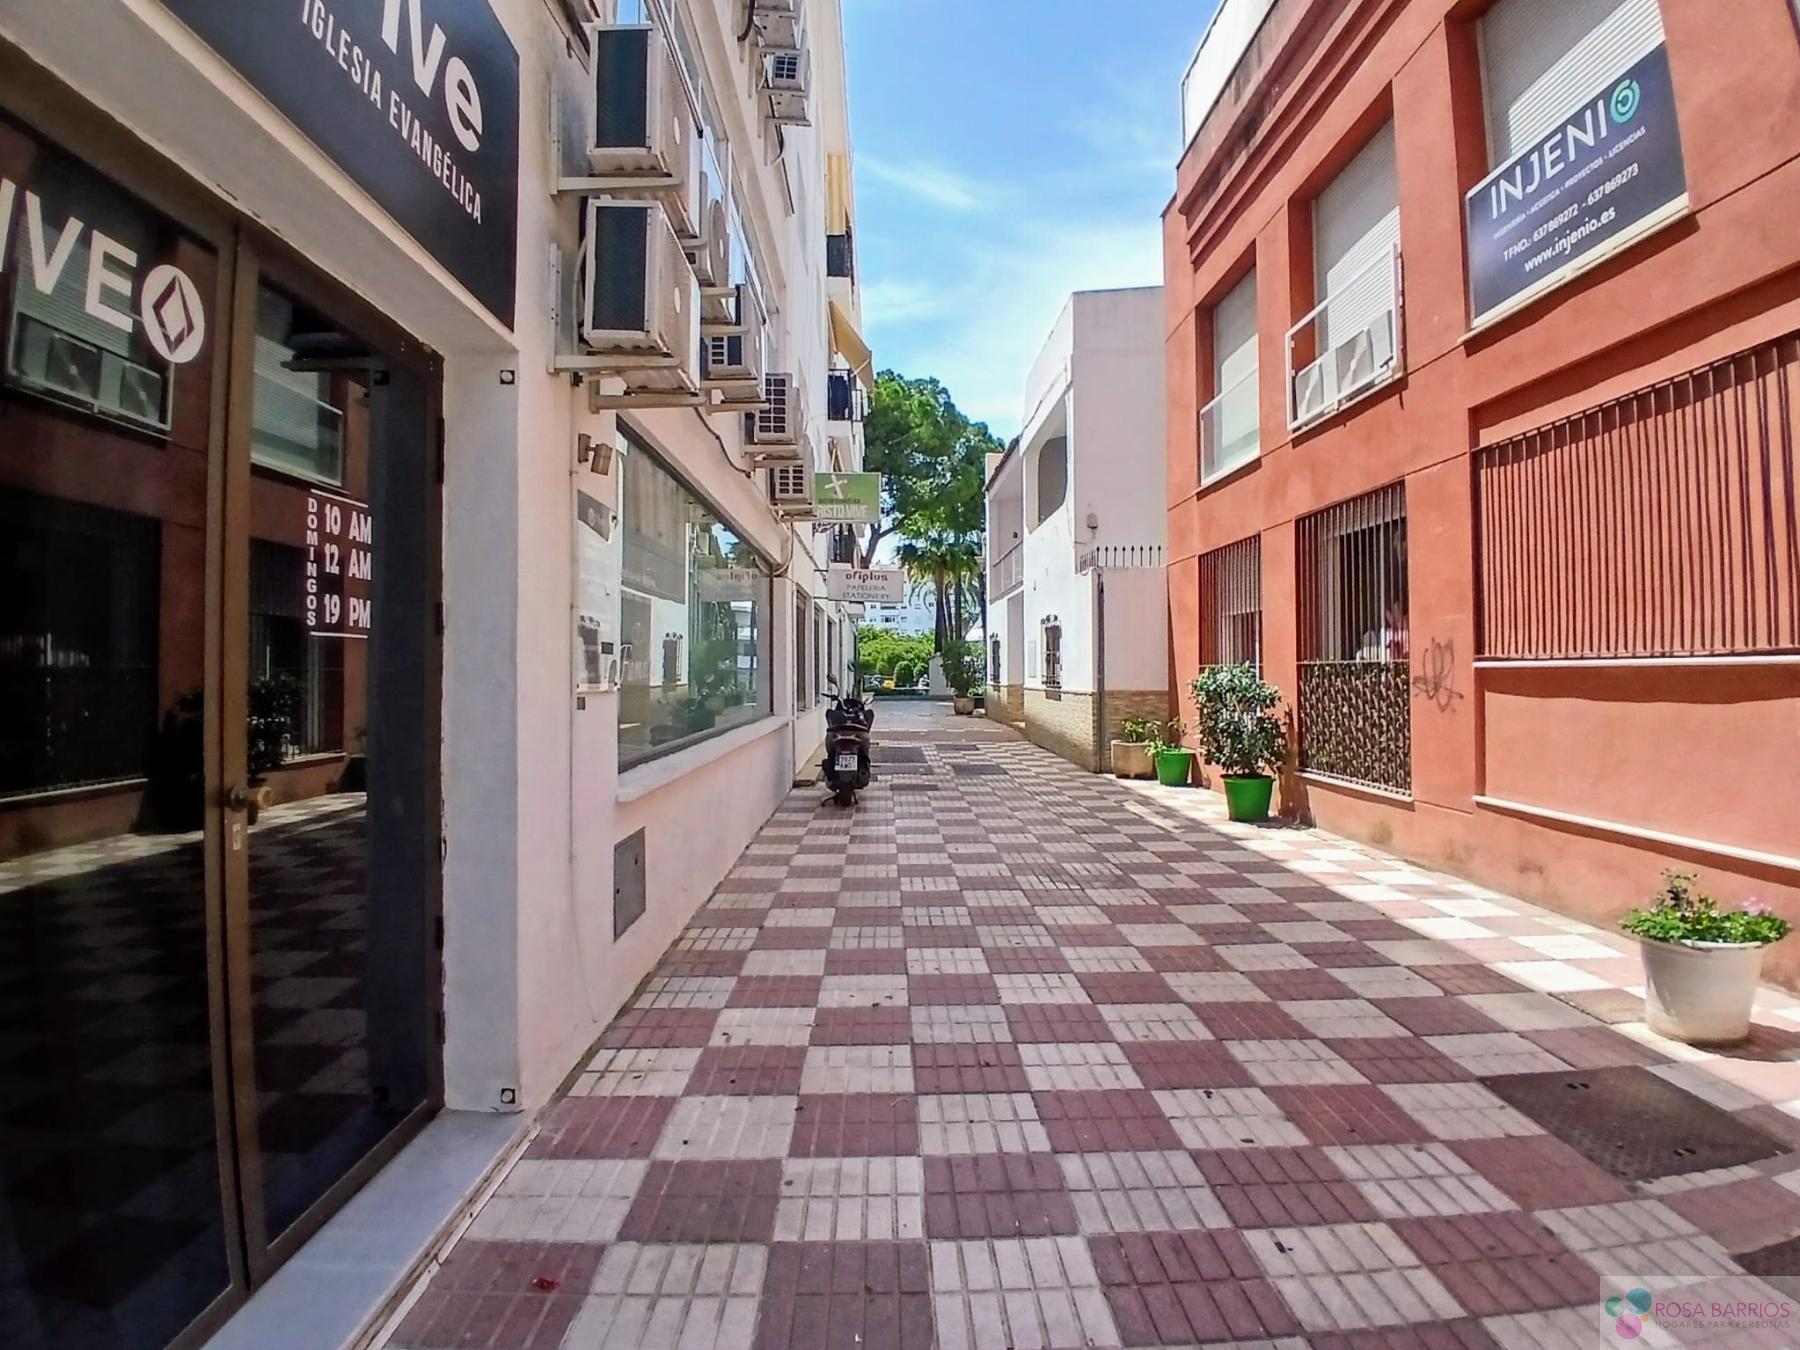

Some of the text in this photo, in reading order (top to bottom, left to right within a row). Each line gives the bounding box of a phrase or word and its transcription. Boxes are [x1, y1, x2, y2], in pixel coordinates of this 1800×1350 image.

[302, 0, 482, 225] IGLESIA EVANGÉLICA
[1524, 206, 1617, 273] www.injenio.es
[324, 503, 372, 545] 10 AM
[306, 497, 318, 627] DOMINGOS
[324, 542, 372, 581] 12 AM
[845, 571, 889, 583] ofiplus
[324, 593, 372, 629] 19 PM
